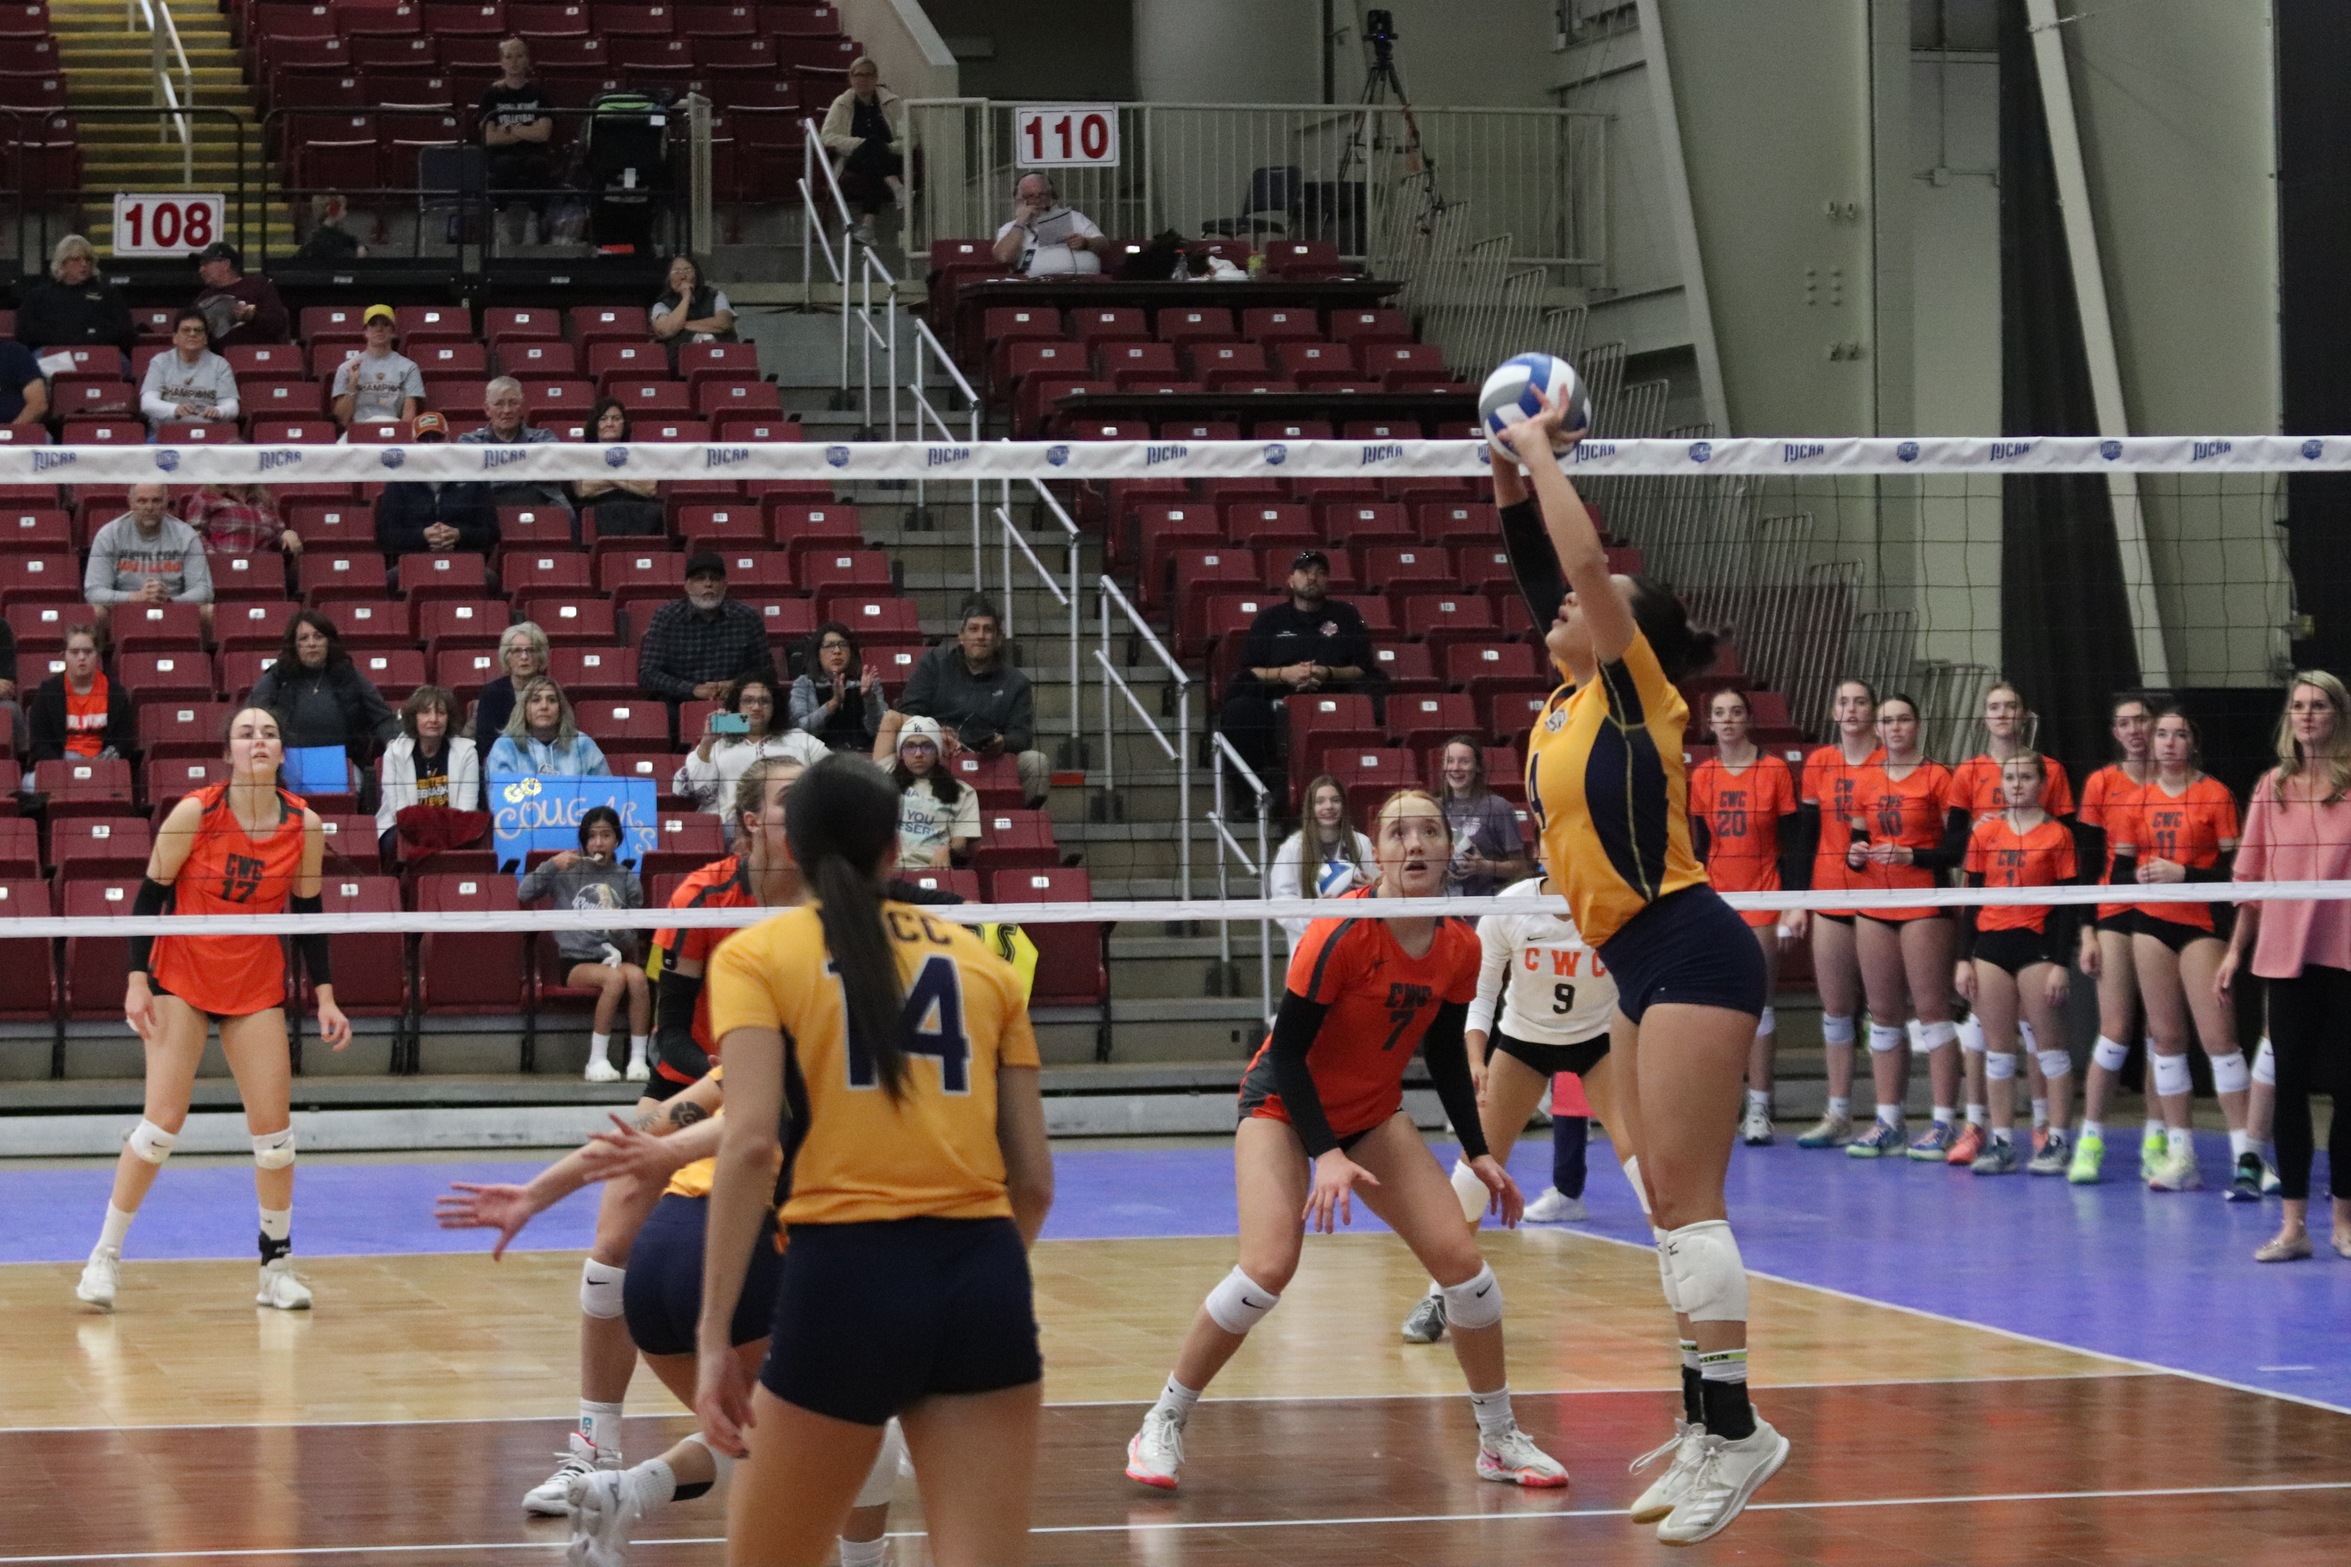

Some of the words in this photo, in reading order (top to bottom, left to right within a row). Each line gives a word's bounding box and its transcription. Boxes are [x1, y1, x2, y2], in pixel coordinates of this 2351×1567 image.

[1025, 113, 1109, 159] 110
[125, 202, 212, 247] 108
[33, 451, 77, 471] NJCAA
[260, 451, 302, 471] NJCAA
[484, 449, 527, 469] NJCAA
[707, 448, 749, 468] NJCAA
[928, 448, 970, 466] NJCAA
[1146, 446, 1188, 466] NJCAA
[1363, 446, 1403, 465] NJCAA
[1576, 444, 1615, 463] NJCAA
[1784, 444, 1824, 462] NJCAA
[1990, 442, 2030, 461] NJCAA
[2193, 442, 2231, 461] NJCAA
[503, 777, 542, 804] GO
[1835, 778, 1856, 793] CW
[1720, 791, 1747, 807] CWC
[907, 809, 935, 826] YOU
[1717, 810, 1747, 837] 20
[1877, 810, 1903, 837] 10
[222, 877, 258, 904] 17
[1552, 982, 1575, 1015] 9
[823, 953, 973, 1095] 14
[1382, 1009, 1415, 1051] 7
